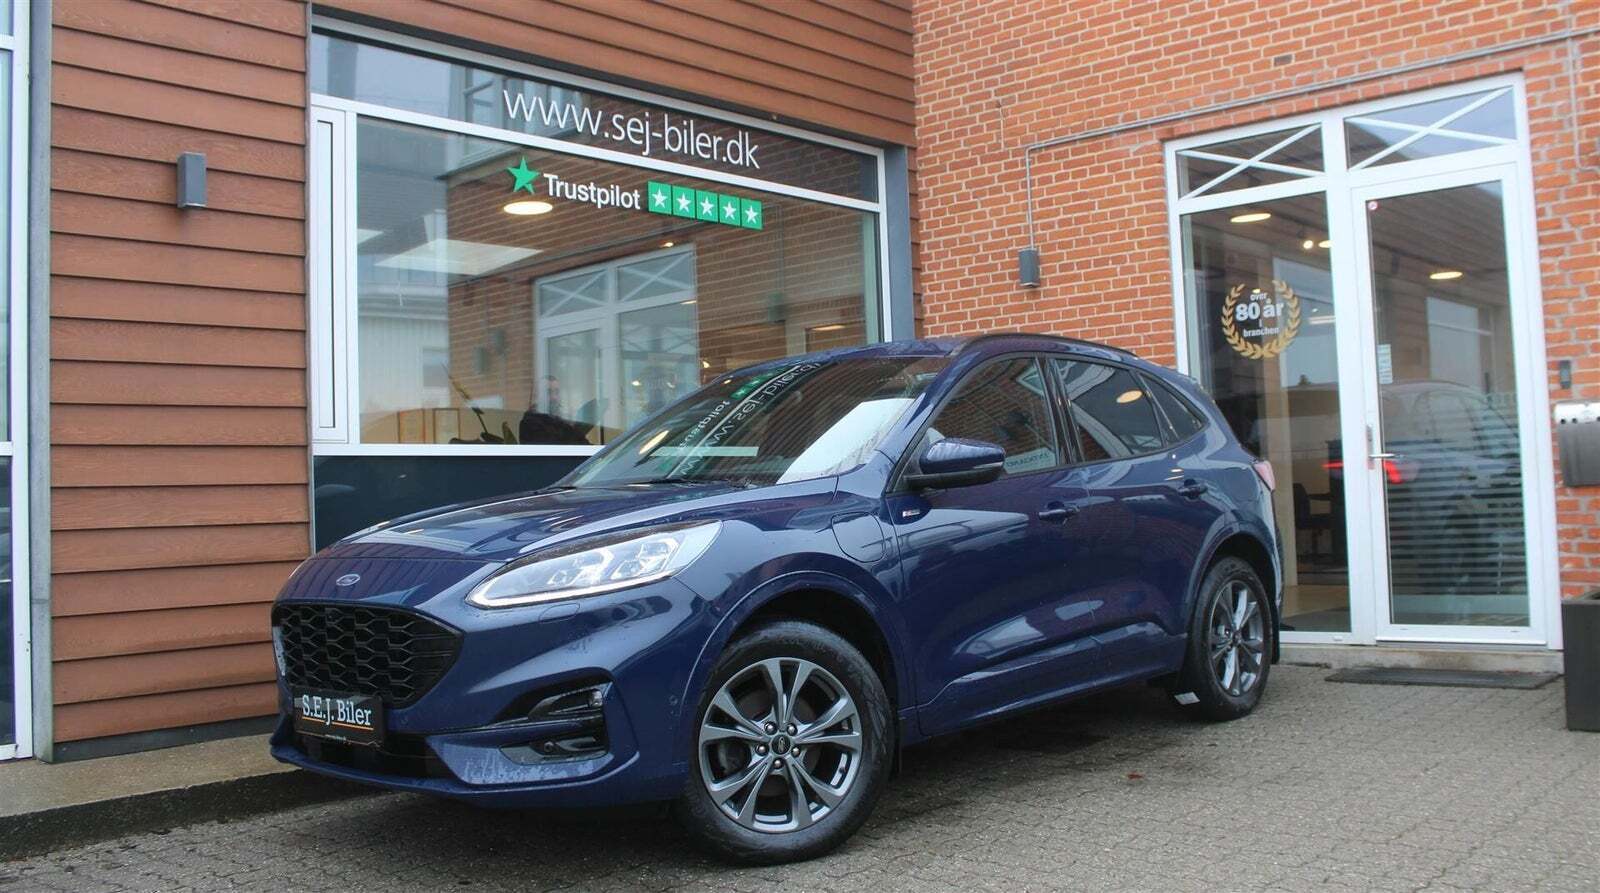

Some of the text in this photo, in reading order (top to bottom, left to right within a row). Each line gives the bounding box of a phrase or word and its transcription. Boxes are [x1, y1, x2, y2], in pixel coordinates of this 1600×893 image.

[503, 90, 760, 169] www.sej-biler.dk
[543, 173, 641, 210] Trustpilot
[1235, 298, 1285, 322] 80 år
[1250, 292, 1268, 301] over
[1243, 327, 1279, 337] branchen
[302, 694, 372, 726] S.E.J. Biler
